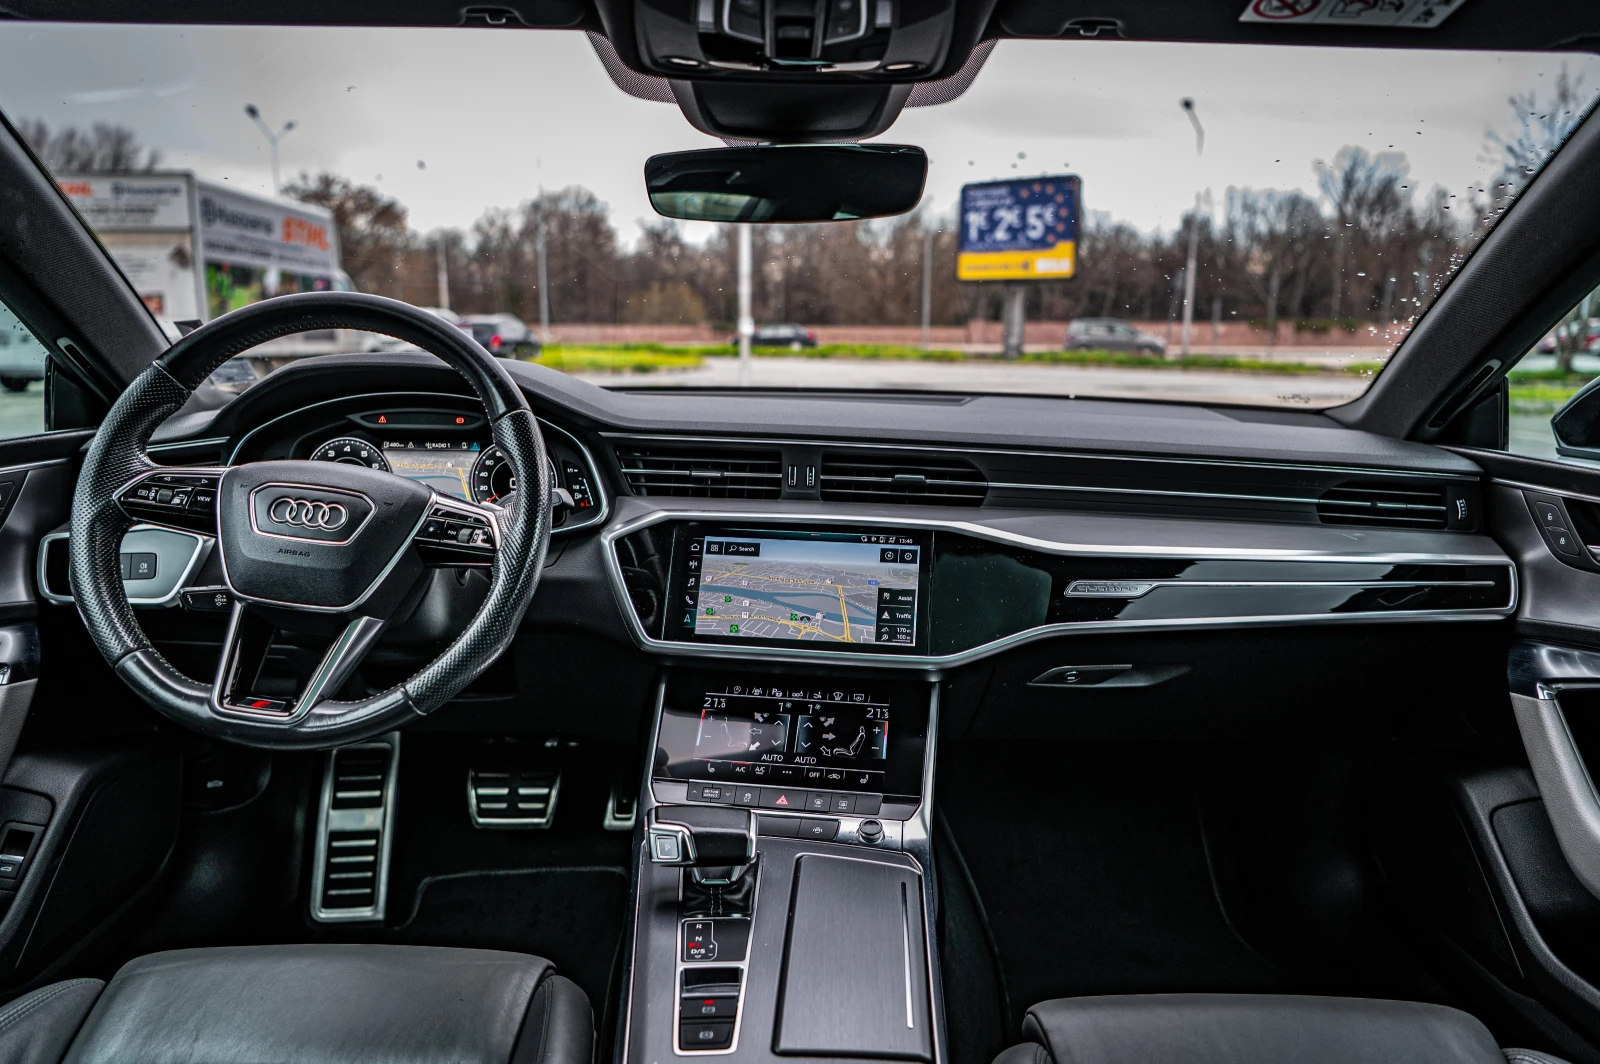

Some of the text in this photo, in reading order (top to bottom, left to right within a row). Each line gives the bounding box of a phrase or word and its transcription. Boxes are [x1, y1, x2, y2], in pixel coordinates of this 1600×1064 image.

[277, 548, 311, 558] AIRBAG
[1076, 582, 1140, 593] quattro
[760, 753, 784, 762] AUTO
[794, 756, 817, 764] AUTO
[665, 843, 671, 851] P
